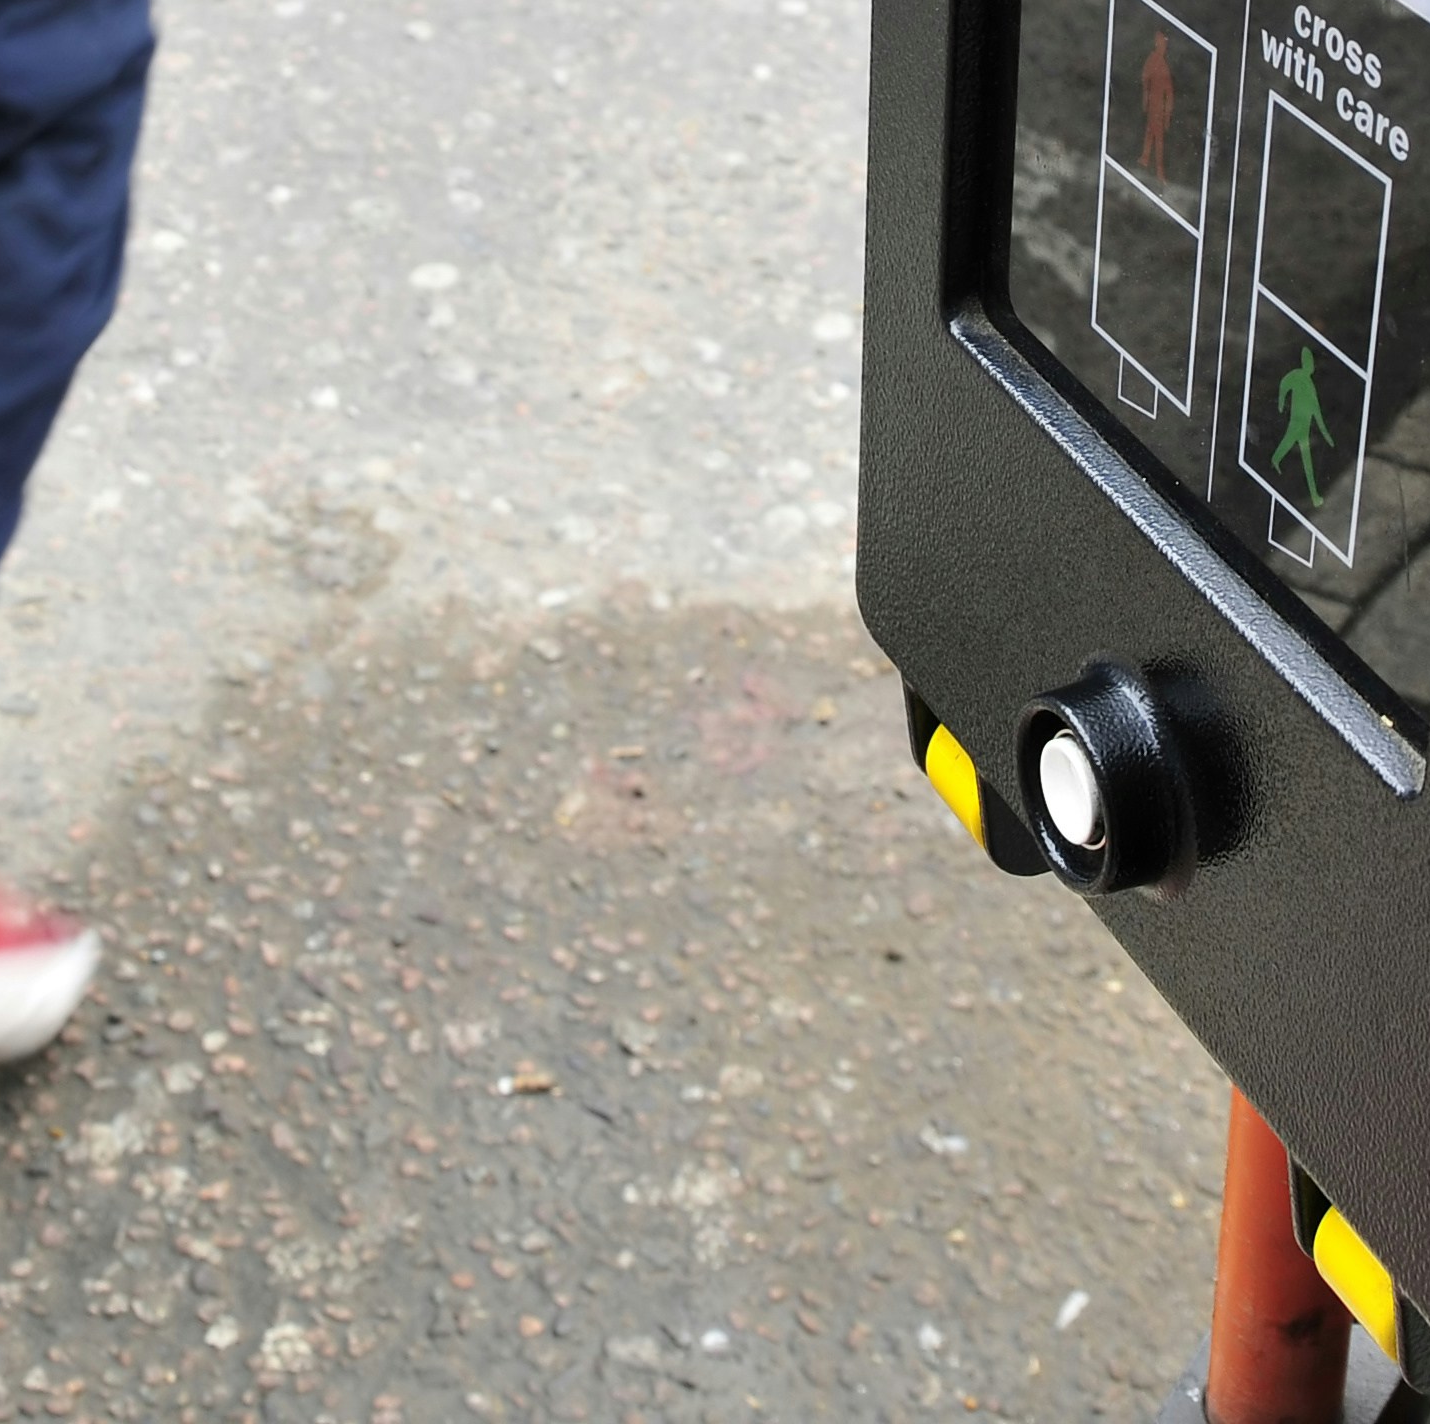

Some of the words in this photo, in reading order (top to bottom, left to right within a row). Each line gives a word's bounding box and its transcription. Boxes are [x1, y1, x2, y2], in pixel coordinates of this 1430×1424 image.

[1262, 29, 1324, 102] with
[1336, 87, 1410, 162] care
[1294, 5, 1382, 89] cross
